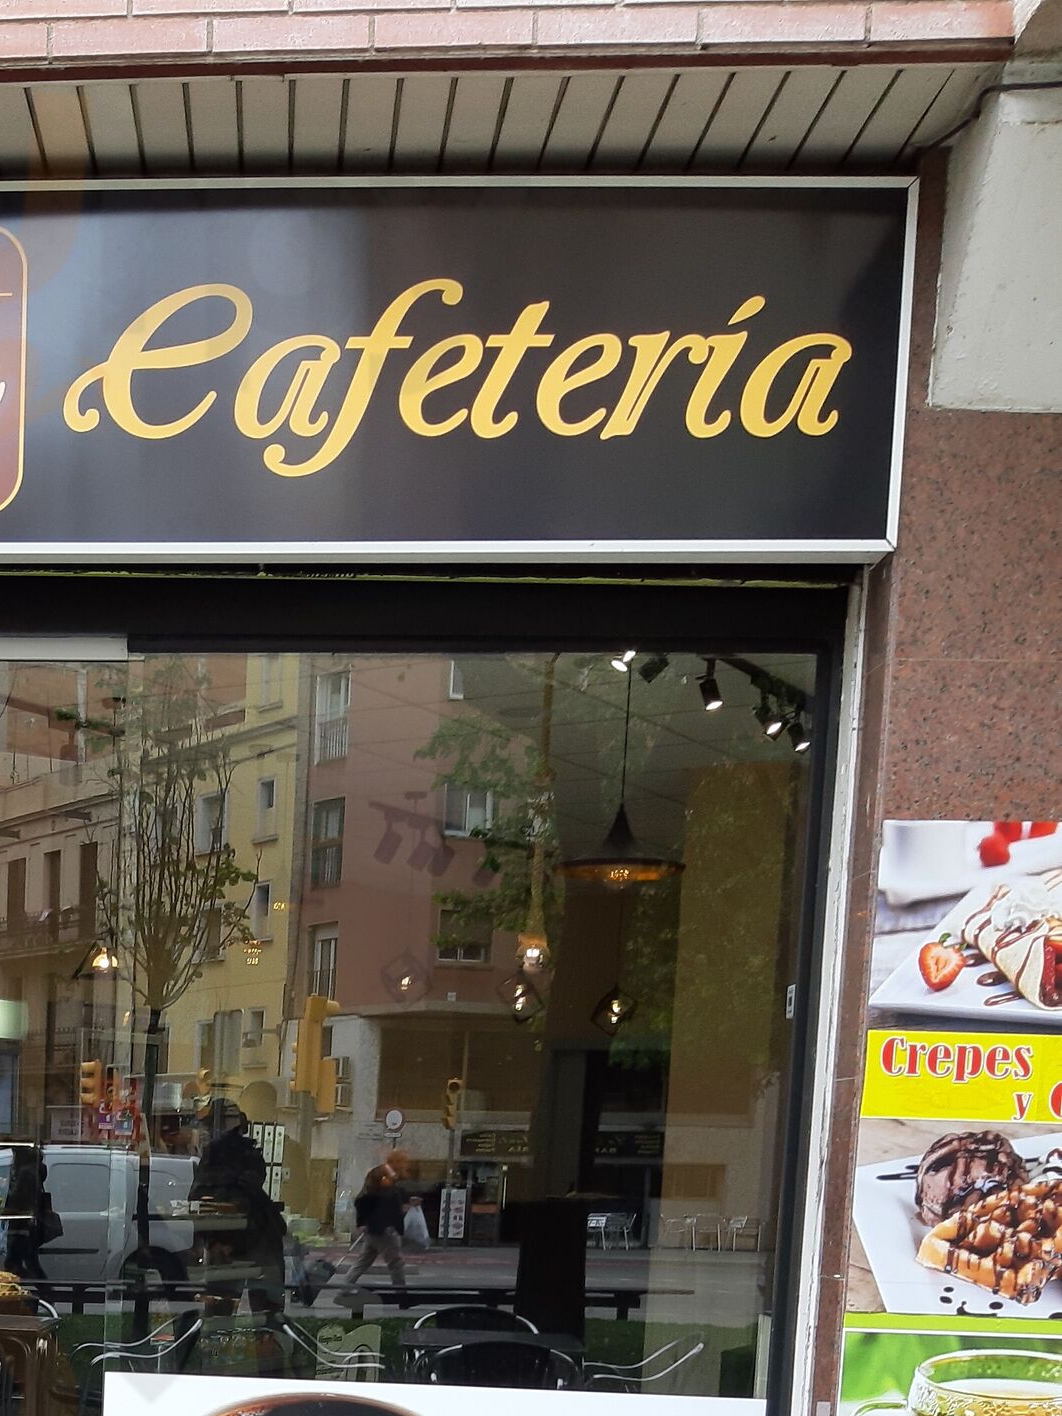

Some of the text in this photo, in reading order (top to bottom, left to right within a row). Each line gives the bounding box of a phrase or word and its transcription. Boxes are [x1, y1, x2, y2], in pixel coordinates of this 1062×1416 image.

[63, 278, 853, 477] Cafetería
[880, 1036, 1034, 1084] Crepes
[1013, 1092, 1033, 1120] y
